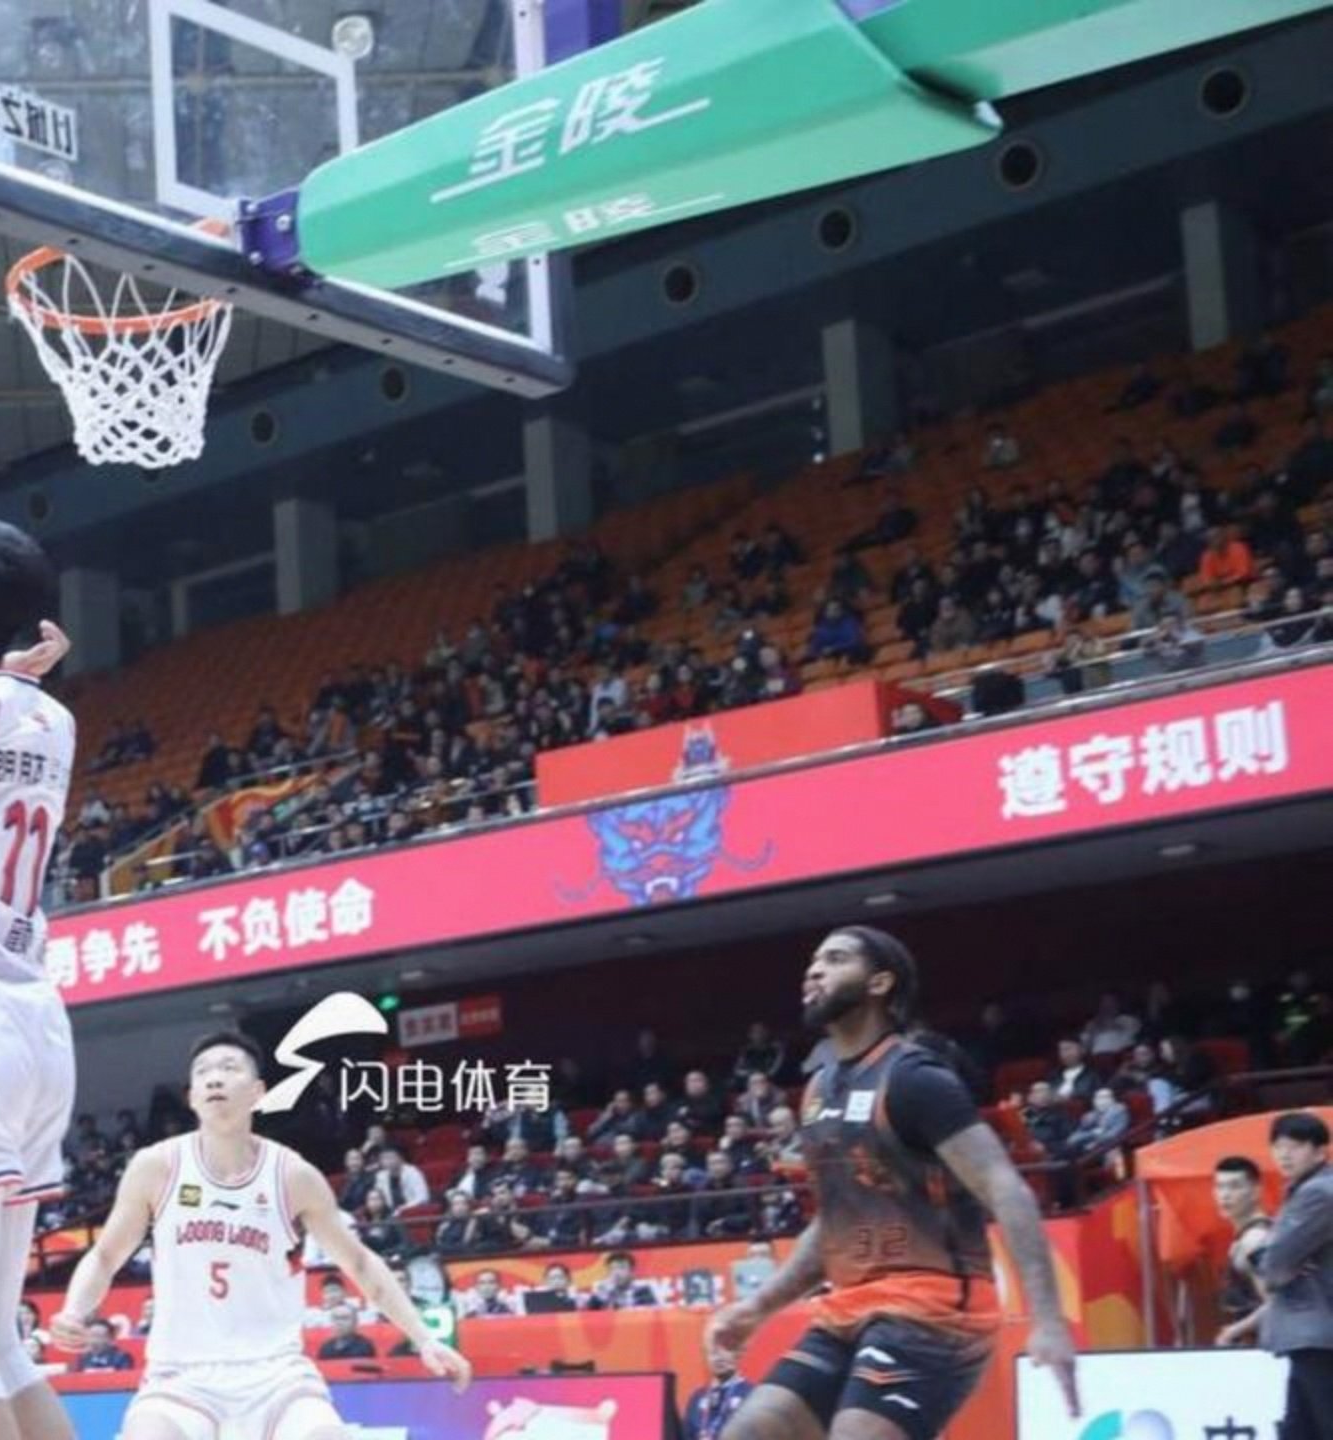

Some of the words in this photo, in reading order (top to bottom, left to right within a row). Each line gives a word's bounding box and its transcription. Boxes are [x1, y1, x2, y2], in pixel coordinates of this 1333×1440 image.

[430, 56, 711, 202] 金陵
[999, 702, 1288, 818] 遵守规则
[0, 799, 50, 917] 11
[198, 880, 374, 960] 不负使命
[208, 1261, 230, 1300] 5
